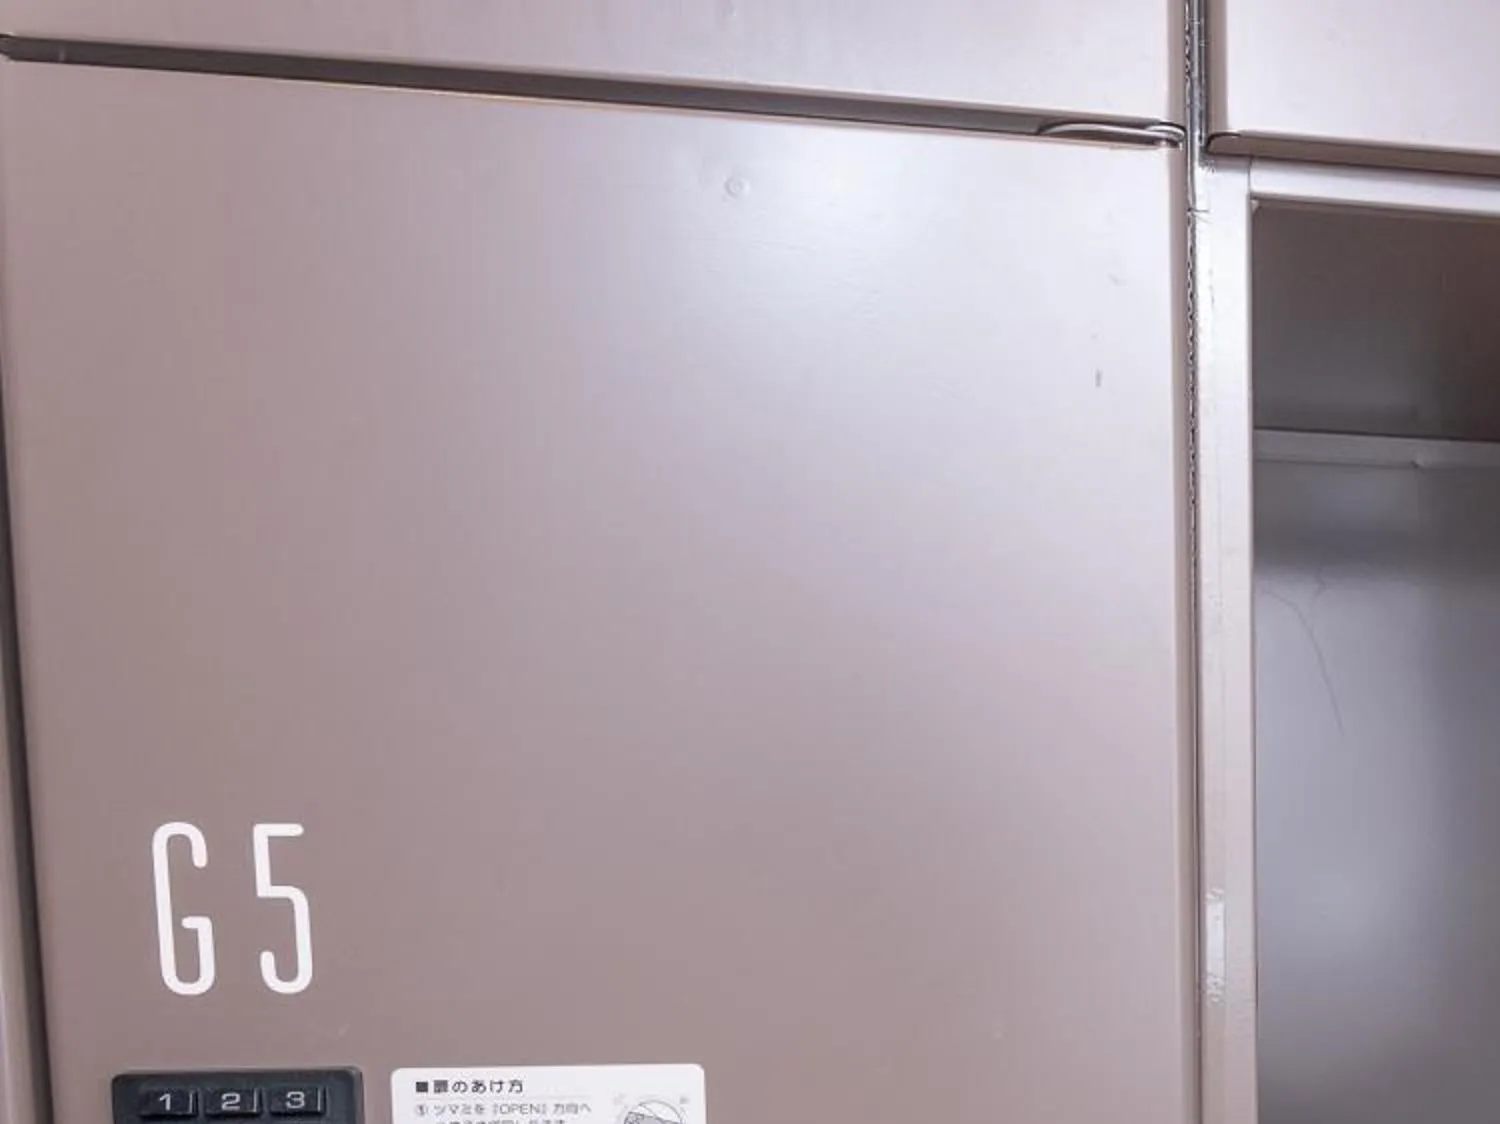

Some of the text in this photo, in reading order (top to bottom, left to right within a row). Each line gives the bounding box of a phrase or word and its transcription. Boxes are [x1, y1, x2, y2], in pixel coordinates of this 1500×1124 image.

[159, 1091, 305, 1112] 1 2 3
